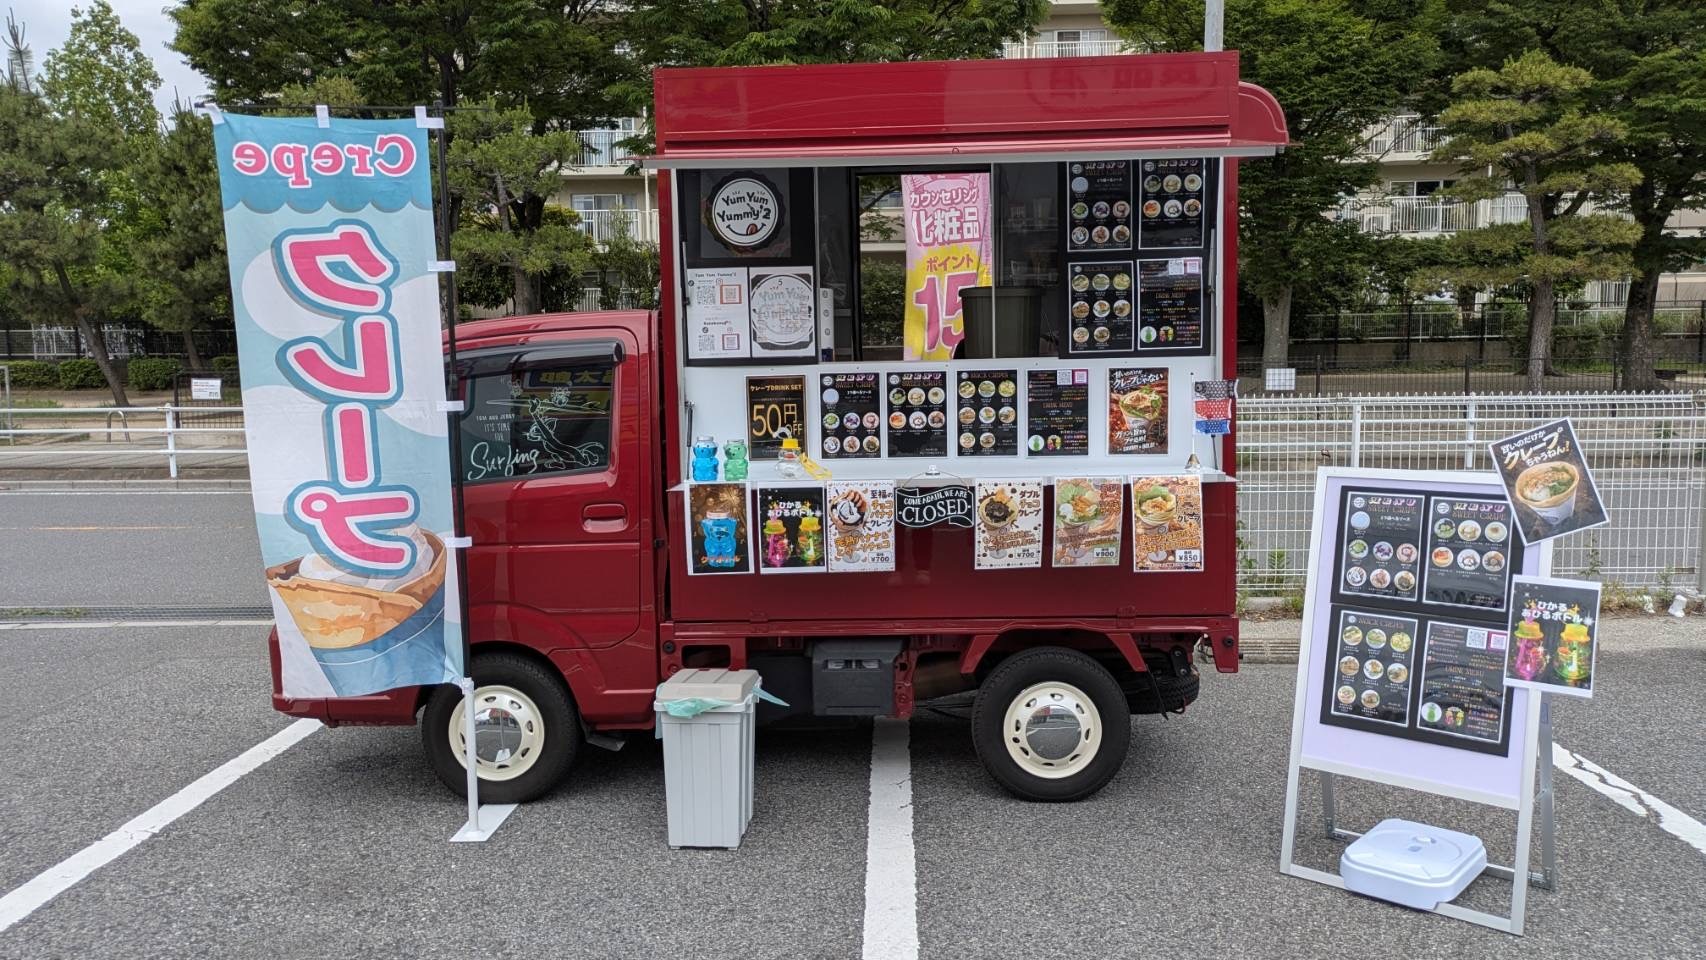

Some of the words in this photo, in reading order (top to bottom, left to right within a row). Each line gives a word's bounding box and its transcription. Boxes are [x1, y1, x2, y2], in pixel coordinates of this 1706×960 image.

[722, 195, 745, 206] Yum
[746, 192, 768, 205] Yum
[910, 187, 978, 206] カウンセリング
[912, 206, 980, 244] 化粧品
[926, 254, 974, 272] ポイント
[1504, 426, 1563, 470] クレープ
[468, 441, 540, 480] Surfing
[954, 490, 967, 498] ARE
[1019, 490, 1040, 498] ダブル
[768, 508, 814, 517] あひるボトル
[902, 499, 968, 522] CLOSED
[1538, 601, 1567, 611] ひかる
[1521, 608, 1583, 622] あひるボトル
